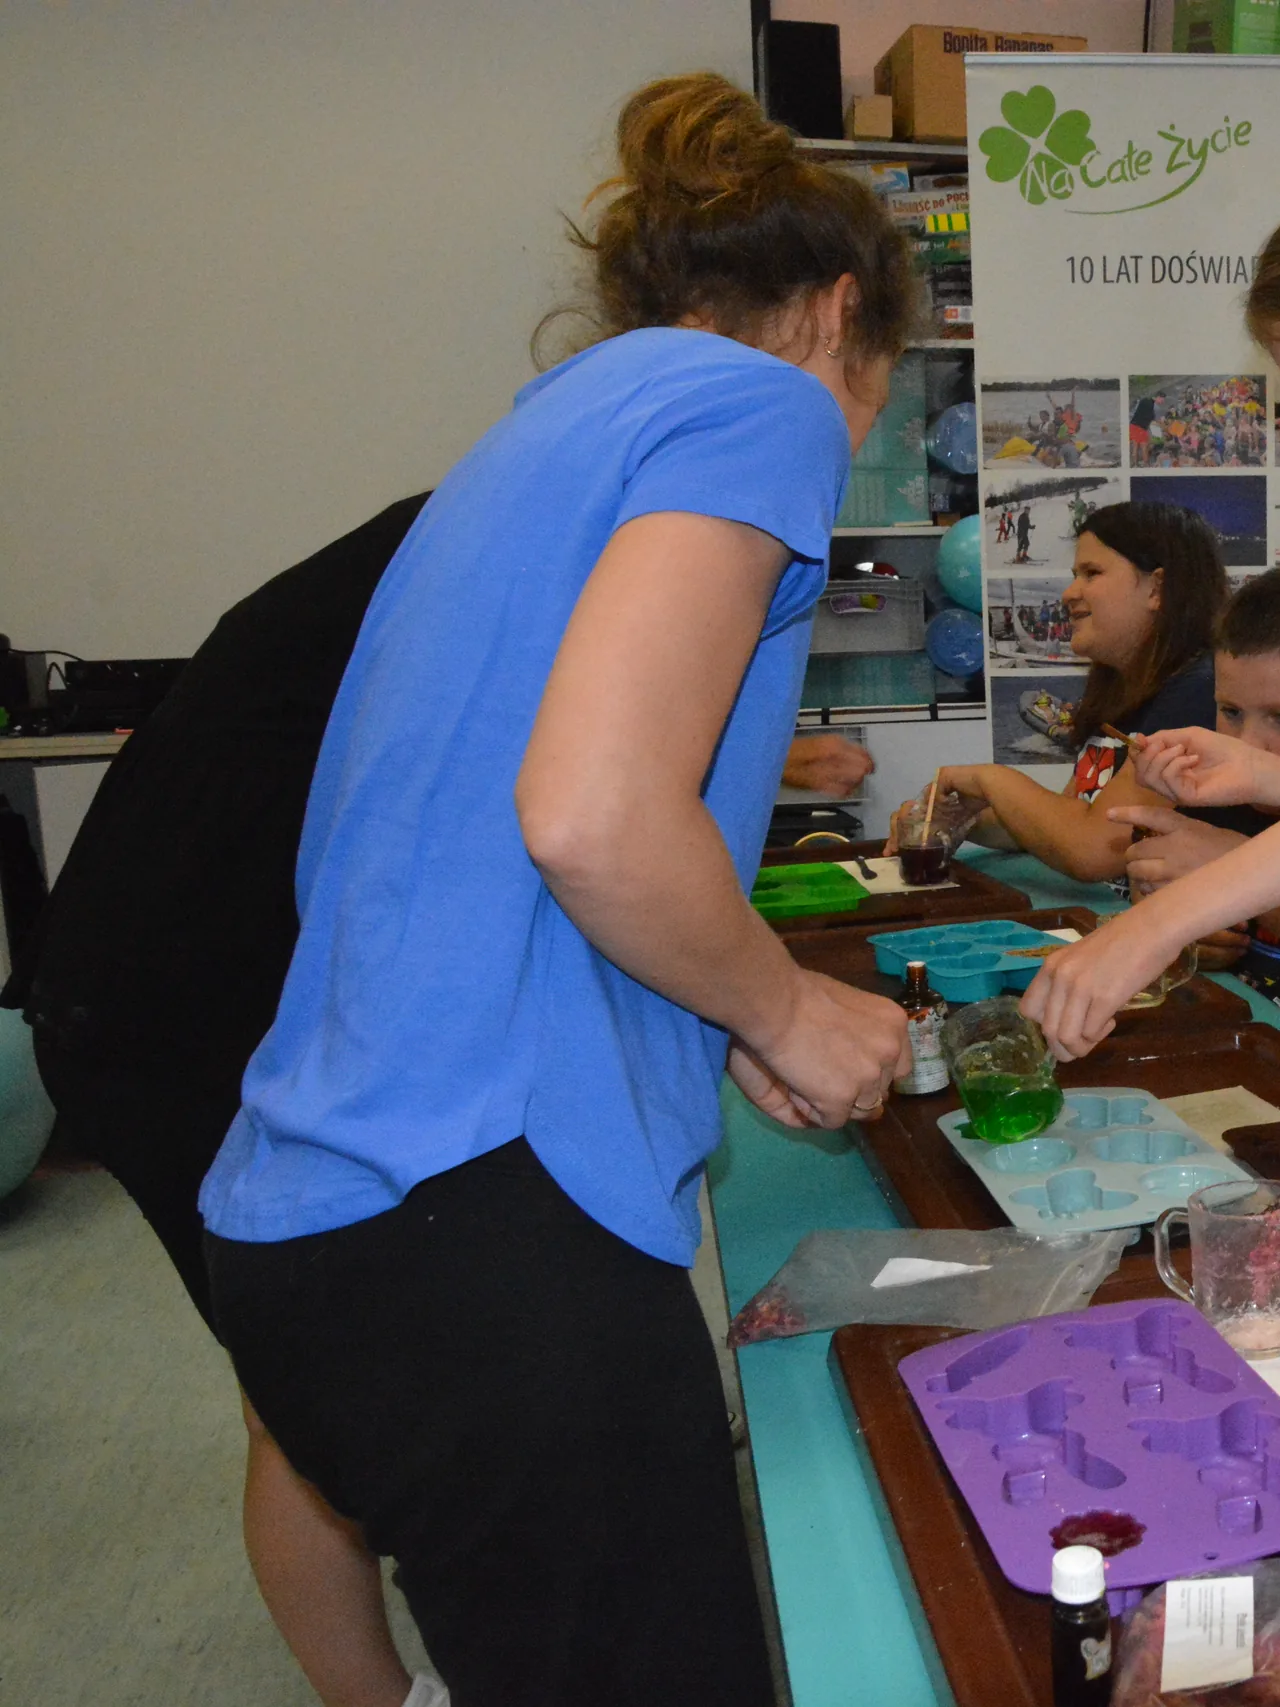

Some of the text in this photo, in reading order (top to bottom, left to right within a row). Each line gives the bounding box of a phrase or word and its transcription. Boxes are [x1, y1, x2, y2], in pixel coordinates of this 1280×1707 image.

[943, 31, 988, 53] Bonita
[1025, 156, 1074, 202] Na
[1157, 115, 1252, 182] Życie
[1066, 255, 1094, 284] 10
[1102, 255, 1143, 284] LAT
